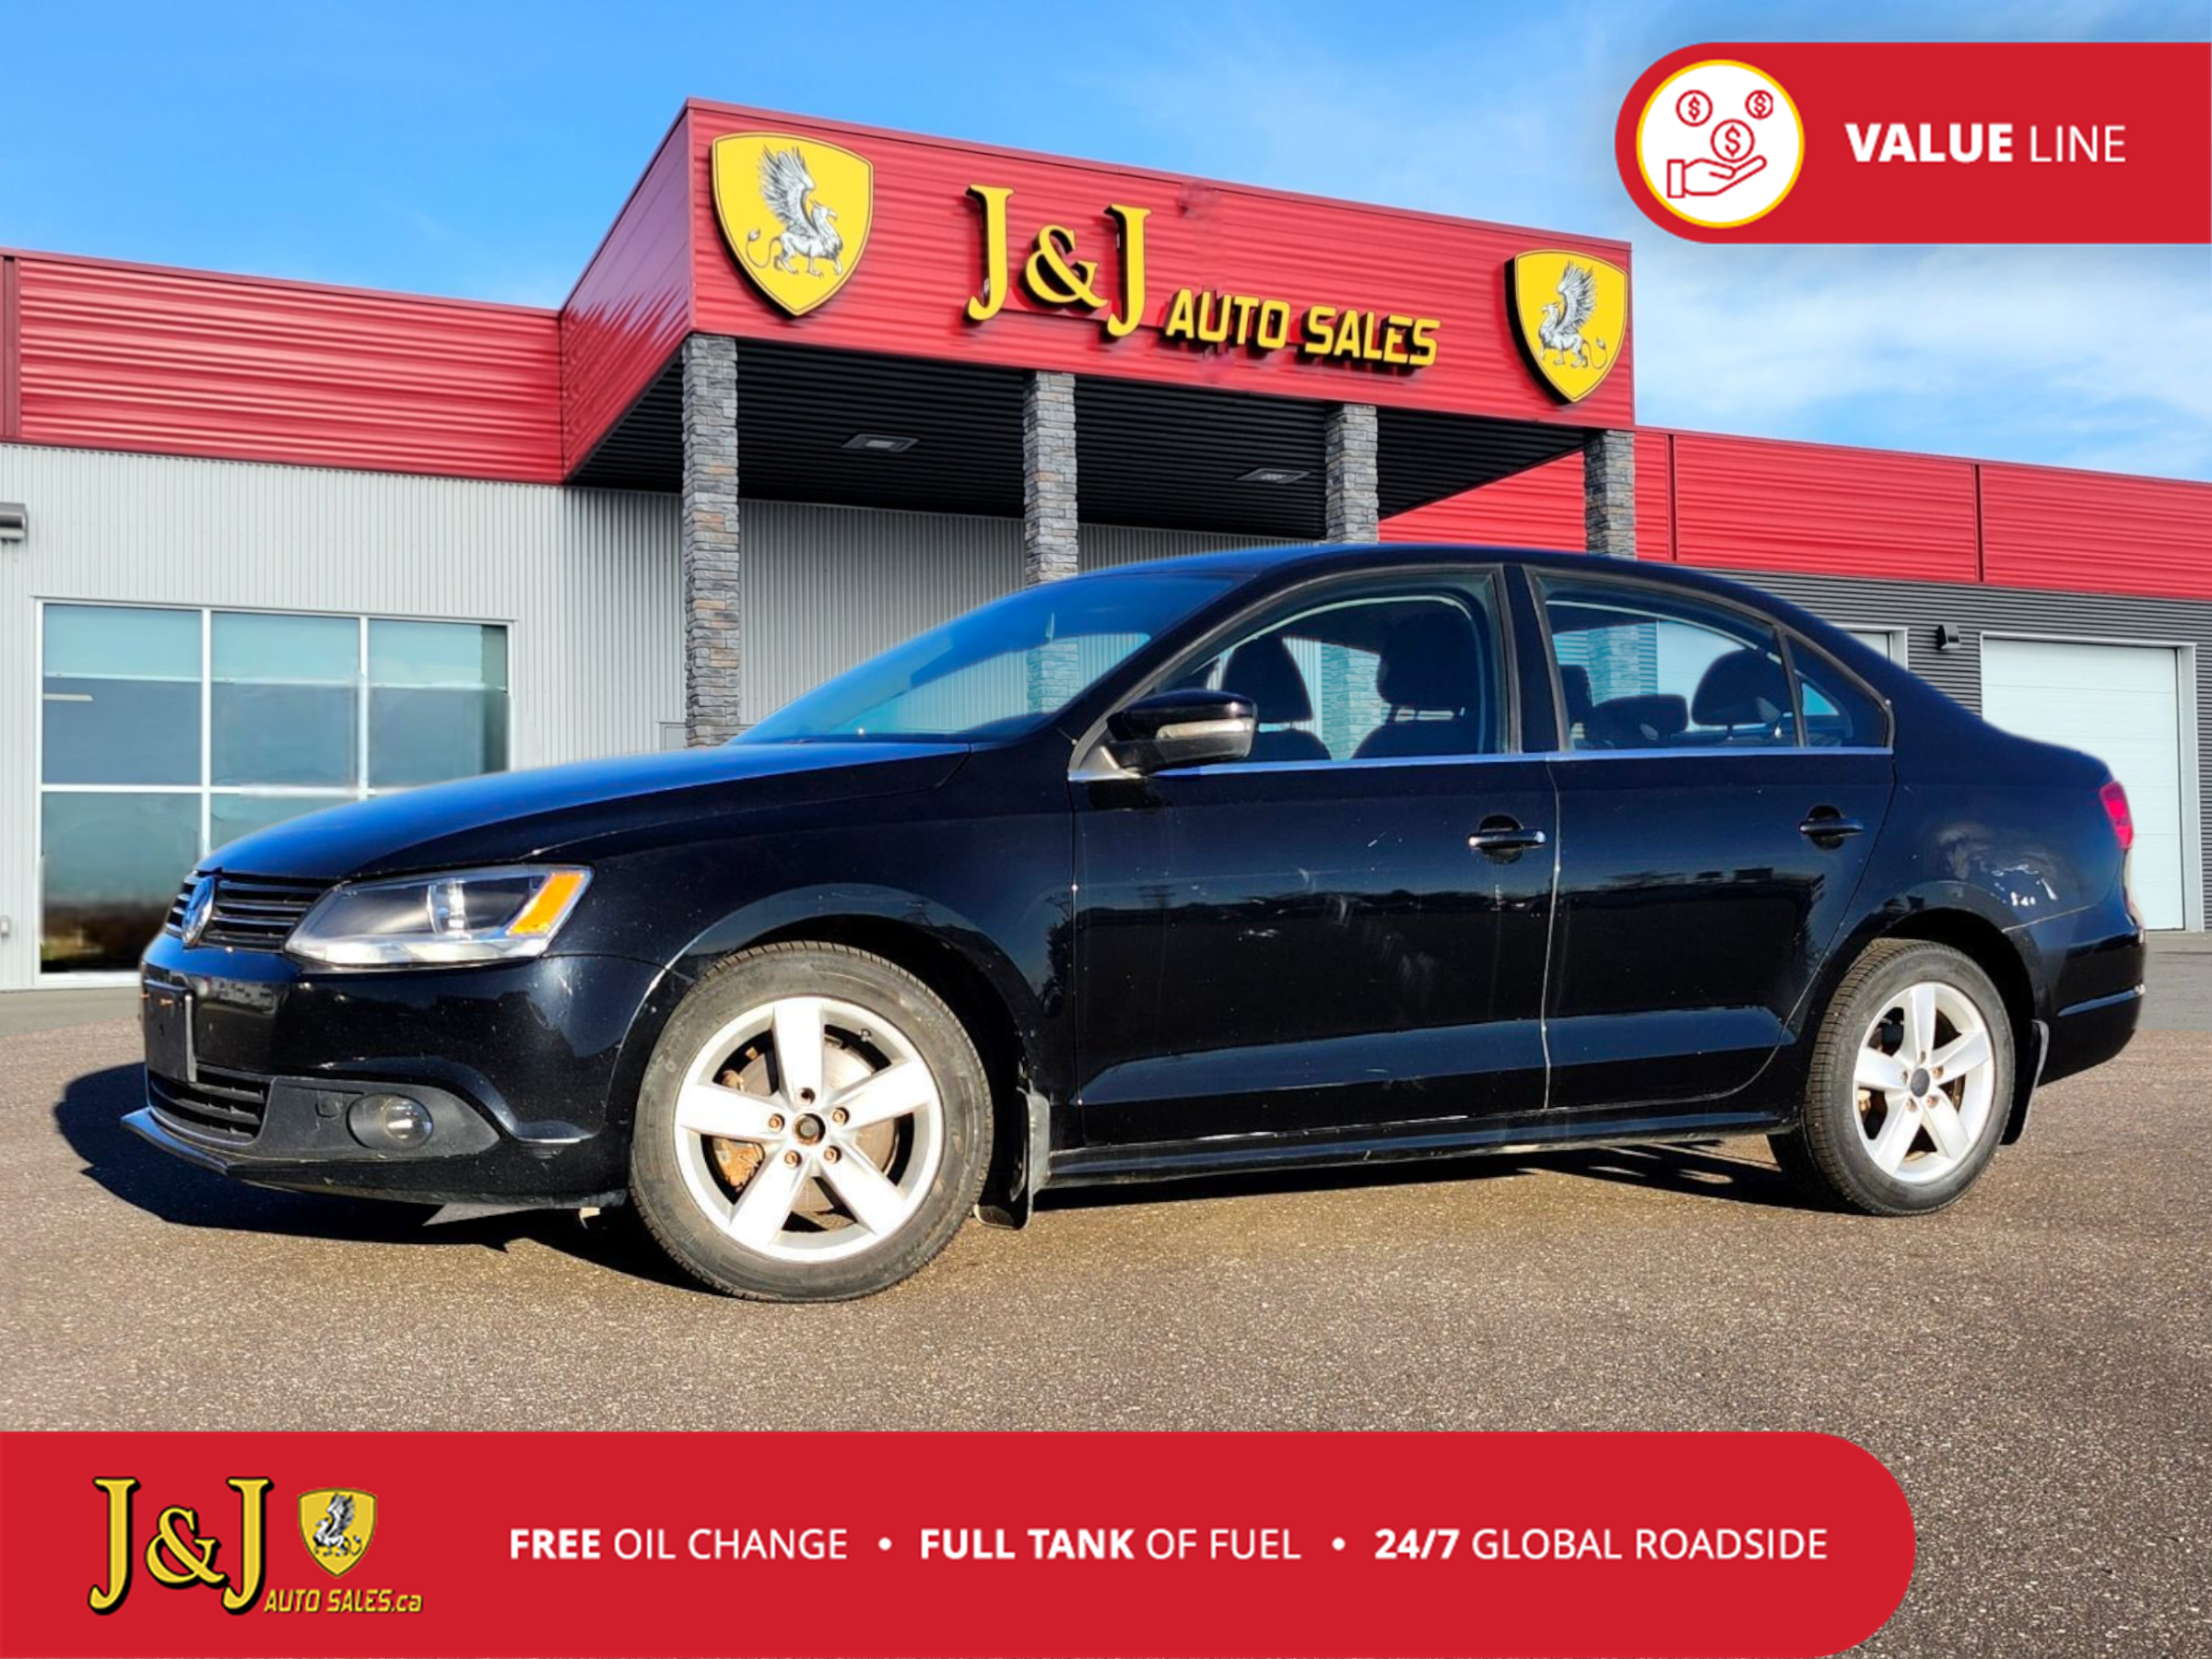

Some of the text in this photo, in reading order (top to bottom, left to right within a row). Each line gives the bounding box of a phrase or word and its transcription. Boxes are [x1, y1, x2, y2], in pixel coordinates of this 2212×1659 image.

[965, 184, 1151, 337] J&J
[1165, 288, 1441, 367] AUTO SALES
